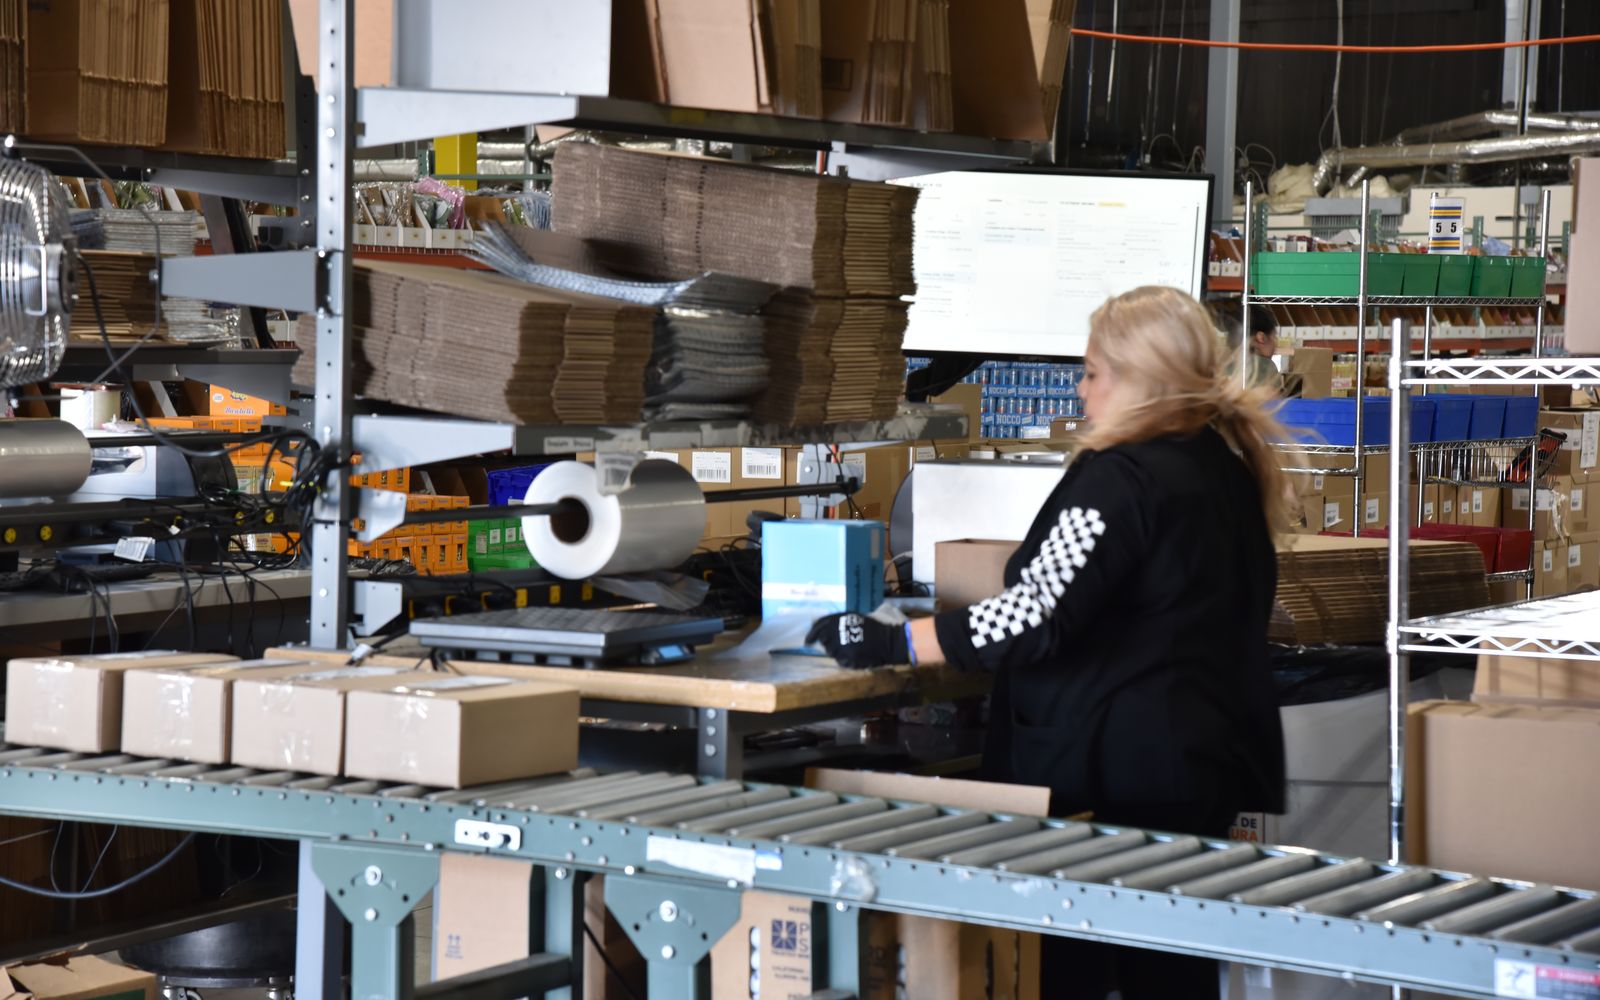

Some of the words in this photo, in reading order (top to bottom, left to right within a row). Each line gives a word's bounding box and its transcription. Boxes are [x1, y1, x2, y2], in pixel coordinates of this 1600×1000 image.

[1435, 222, 1442, 233] 5
[1450, 222, 1457, 233] 5
[996, 415, 1021, 425] NOCCO
[1241, 817, 1257, 829] DE
